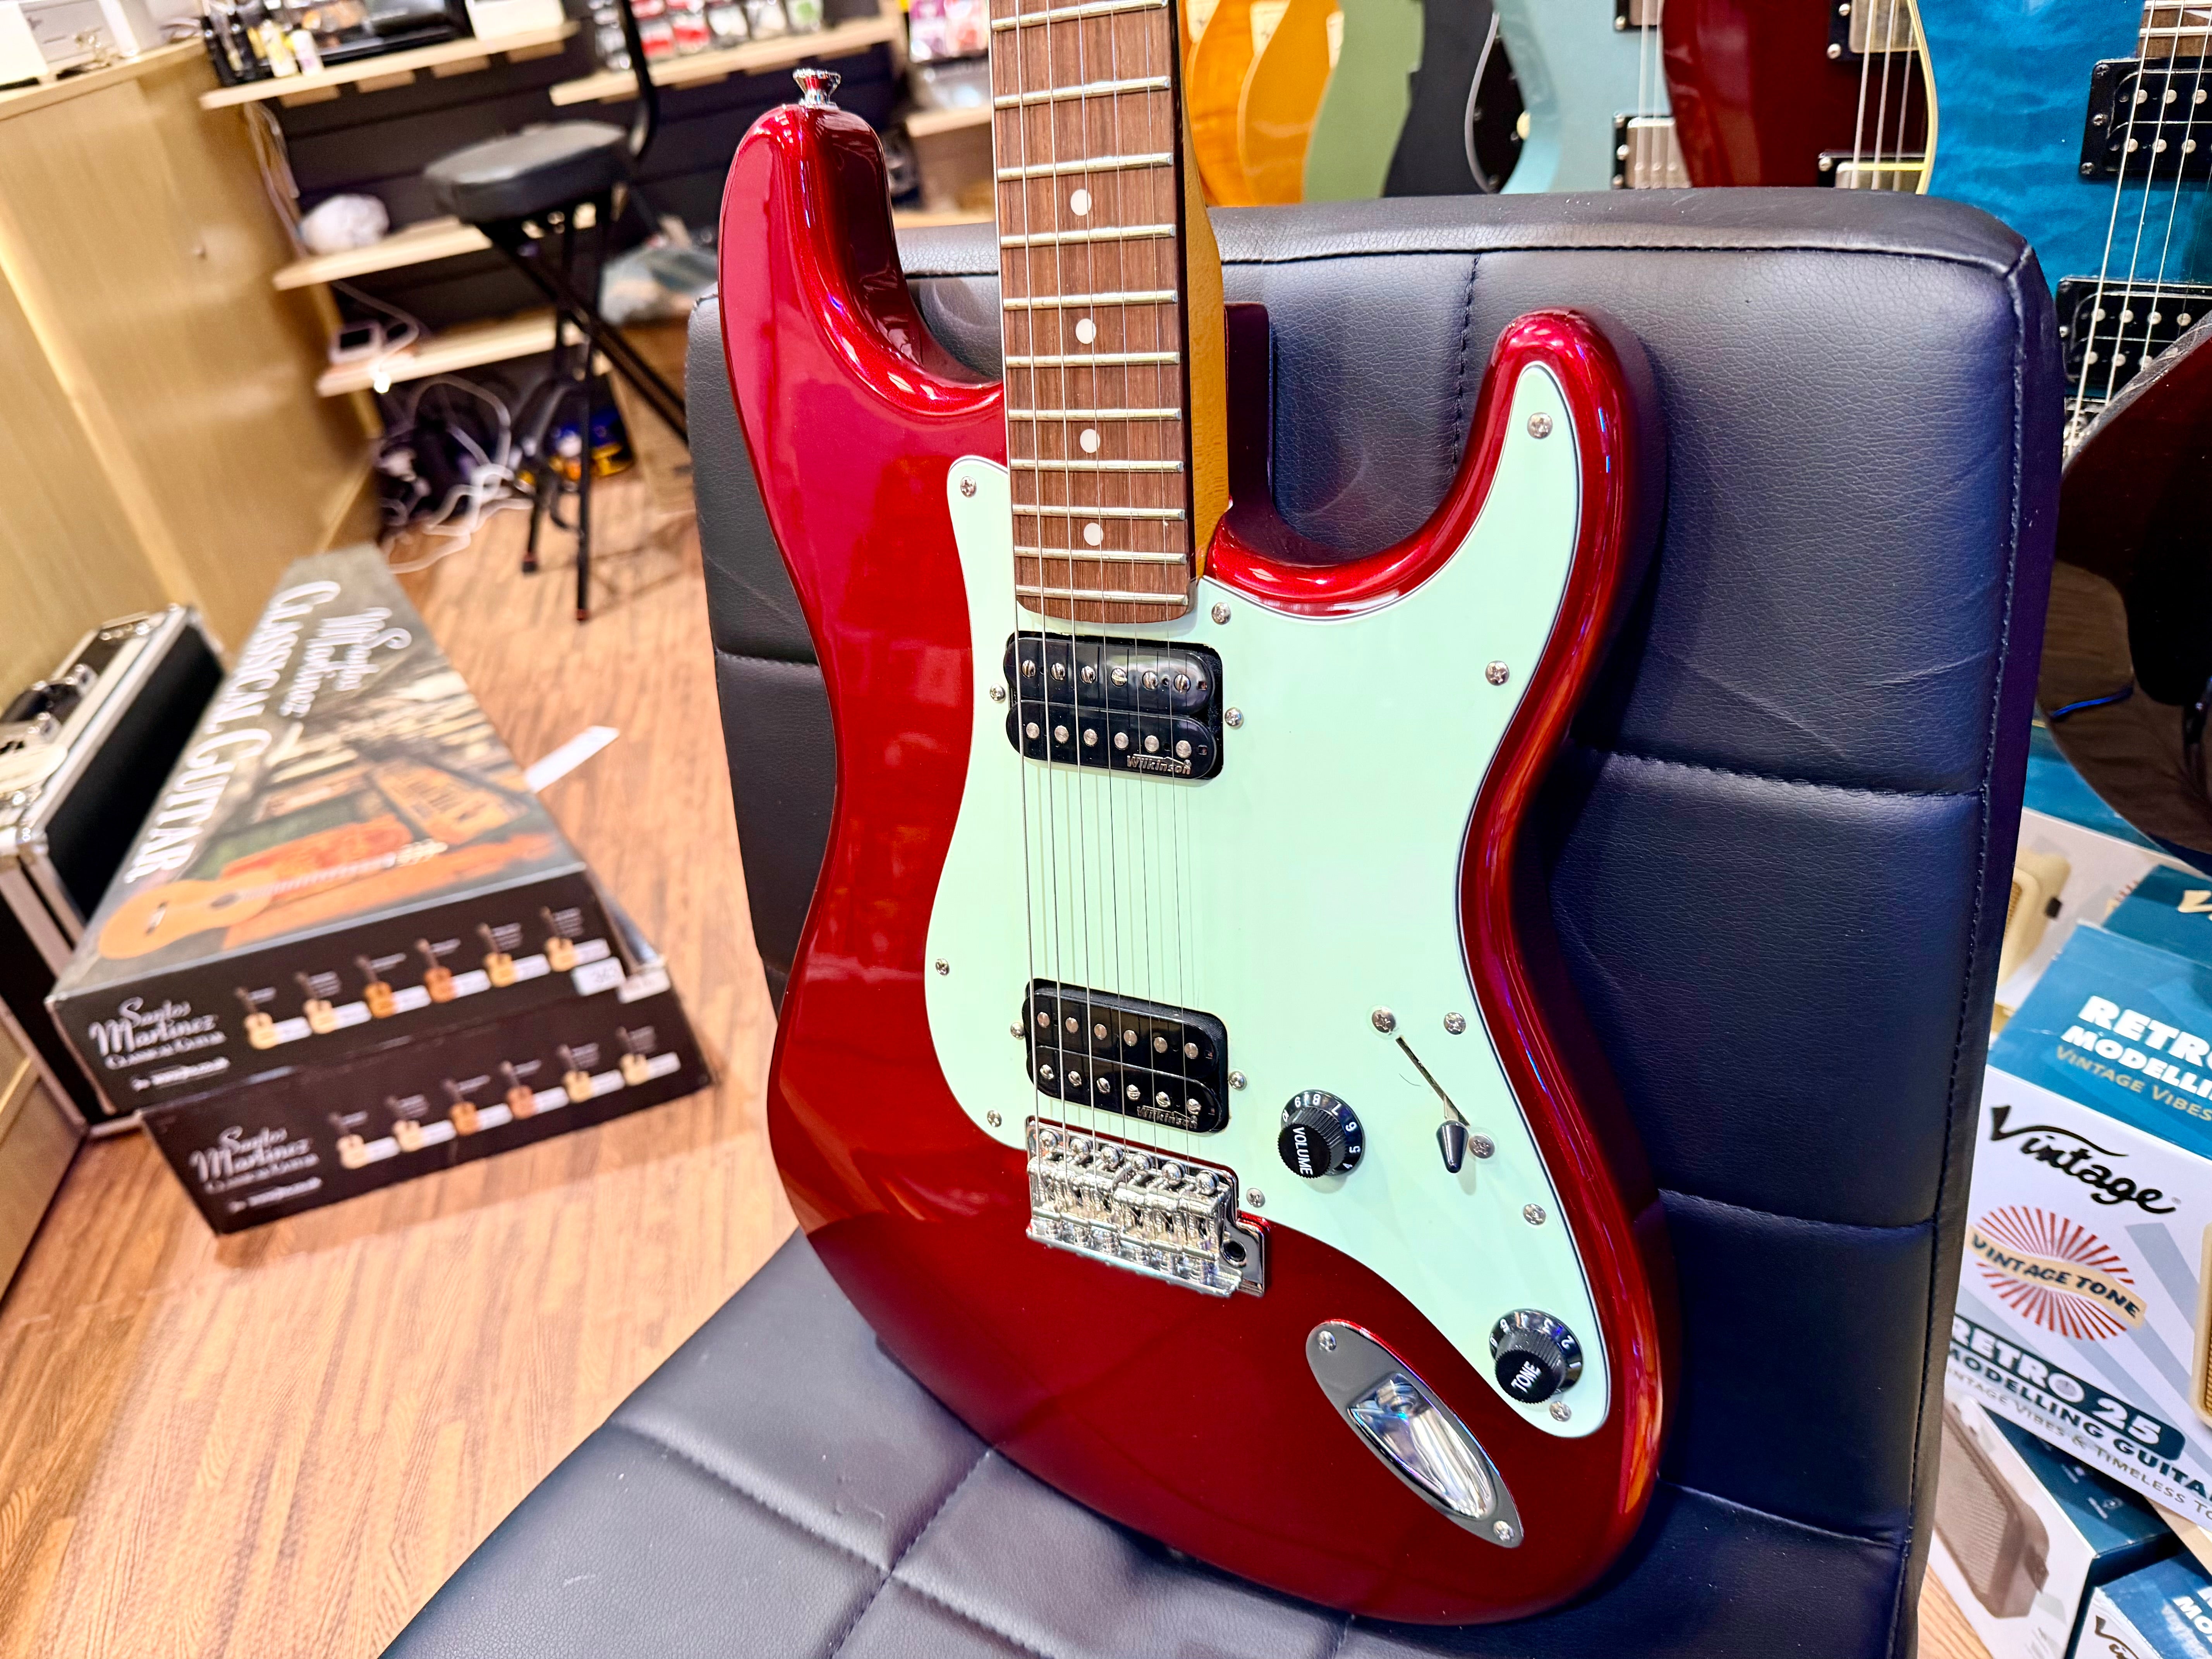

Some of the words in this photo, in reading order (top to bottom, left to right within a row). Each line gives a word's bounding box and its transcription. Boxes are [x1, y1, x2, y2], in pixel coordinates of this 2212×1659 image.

[1127, 754, 1192, 775] Wilkinson
[118, 996, 192, 1028] Santos
[2078, 995, 2212, 1071] RETR
[88, 1014, 219, 1057] Martinez
[2061, 1025, 2212, 1101] MODELLI
[1137, 1105, 1198, 1129] Wilkinson
[1313, 1094, 1321, 1106] 8
[1293, 1127, 1313, 1175] VOLUME
[1990, 1105, 2176, 1214] Vintage
[1972, 1233, 2069, 1285] VINTAGE
[2076, 1274, 2141, 1319] TONE
[1542, 1317, 1555, 1335] 3
[1561, 1335, 1575, 1350] 2
[1511, 1361, 1542, 1394] TONE
[2092, 1398, 2161, 1444] 25
[2095, 1444, 2186, 1504] TIMELESS
[2113, 1438, 2212, 1503] GUITA
